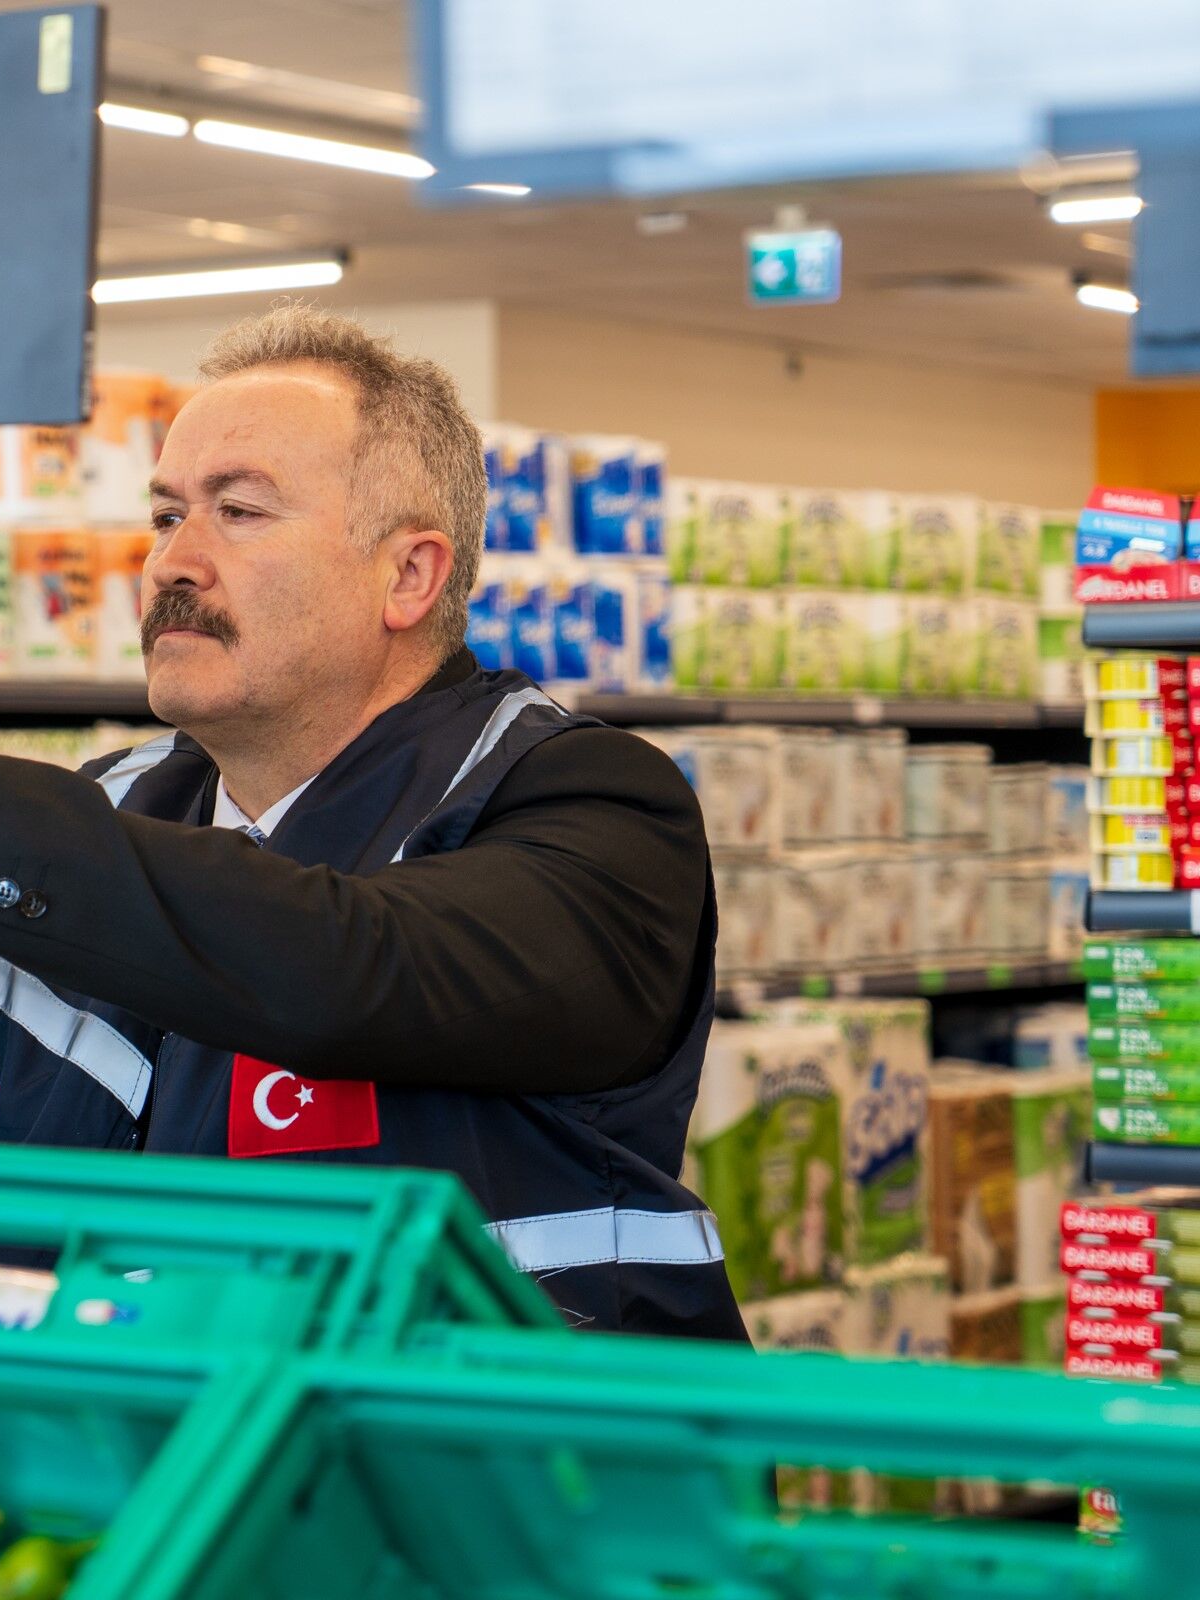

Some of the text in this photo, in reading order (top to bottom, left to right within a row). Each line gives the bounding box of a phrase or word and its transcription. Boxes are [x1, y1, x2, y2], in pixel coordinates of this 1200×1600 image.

[1076, 575, 1169, 600] RDANEL
[1064, 1210, 1151, 1237] DARDANEL
[1065, 1247, 1151, 1273] DARDANEL
[1071, 1283, 1158, 1311] DARDANEL
[1069, 1320, 1156, 1348] DARDANEL
[1068, 1357, 1156, 1379] DARDANEL
